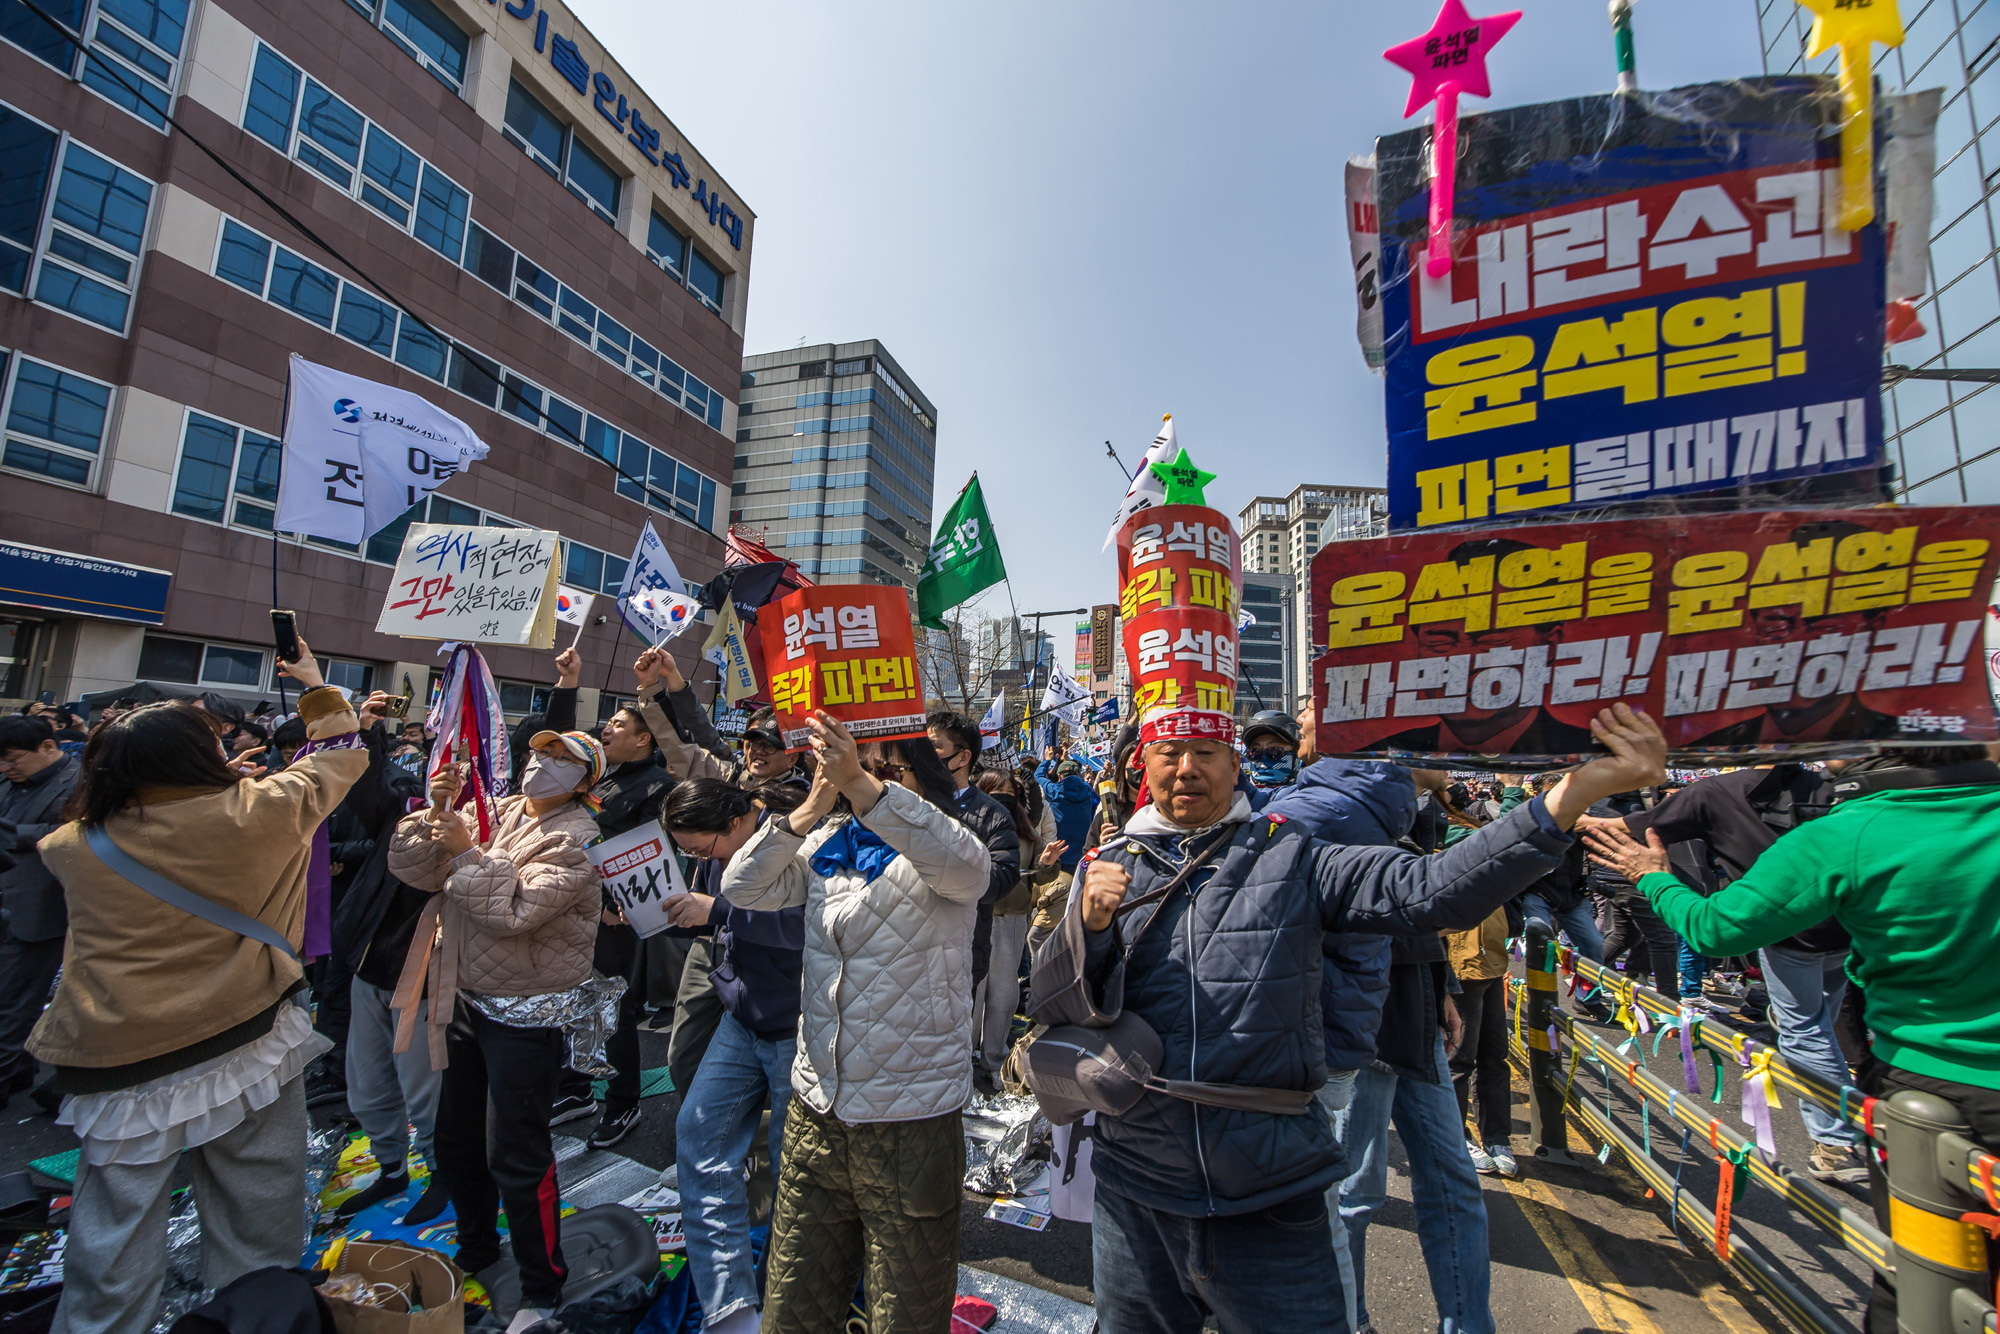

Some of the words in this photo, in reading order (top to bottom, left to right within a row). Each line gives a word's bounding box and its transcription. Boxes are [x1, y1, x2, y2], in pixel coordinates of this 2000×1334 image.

[1424, 25, 1481, 56] 윤석열
[1431, 46, 1469, 69] 파면
[484, 0, 744, 251] 기술안보수사대
[1420, 167, 1852, 334] 내란수괴
[1424, 281, 1807, 441] 윤석열!
[1171, 467, 1198, 480] 윤석열
[1176, 477, 1195, 488] 파면
[54, 556, 138, 578] 산업기술안보수사대
[1131, 521, 1232, 571] 윤석열
[389, 573, 456, 621] 그만
[1121, 567, 1177, 622] 즉각
[1328, 541, 1654, 649] 윤석열을
[1668, 526, 1991, 636] 윤석열을
[783, 605, 880, 661] 윤석열
[1138, 628, 1236, 682] 윤석열
[771, 664, 812, 715] 즉각
[820, 656, 917, 705] 파면!
[1322, 631, 1663, 724] 파면하라!
[1664, 619, 1983, 717] 파면하라!
[1154, 713, 1192, 737] 단결
[1897, 716, 1966, 733] 민주당
[603, 842, 658, 875] 국민의힘
